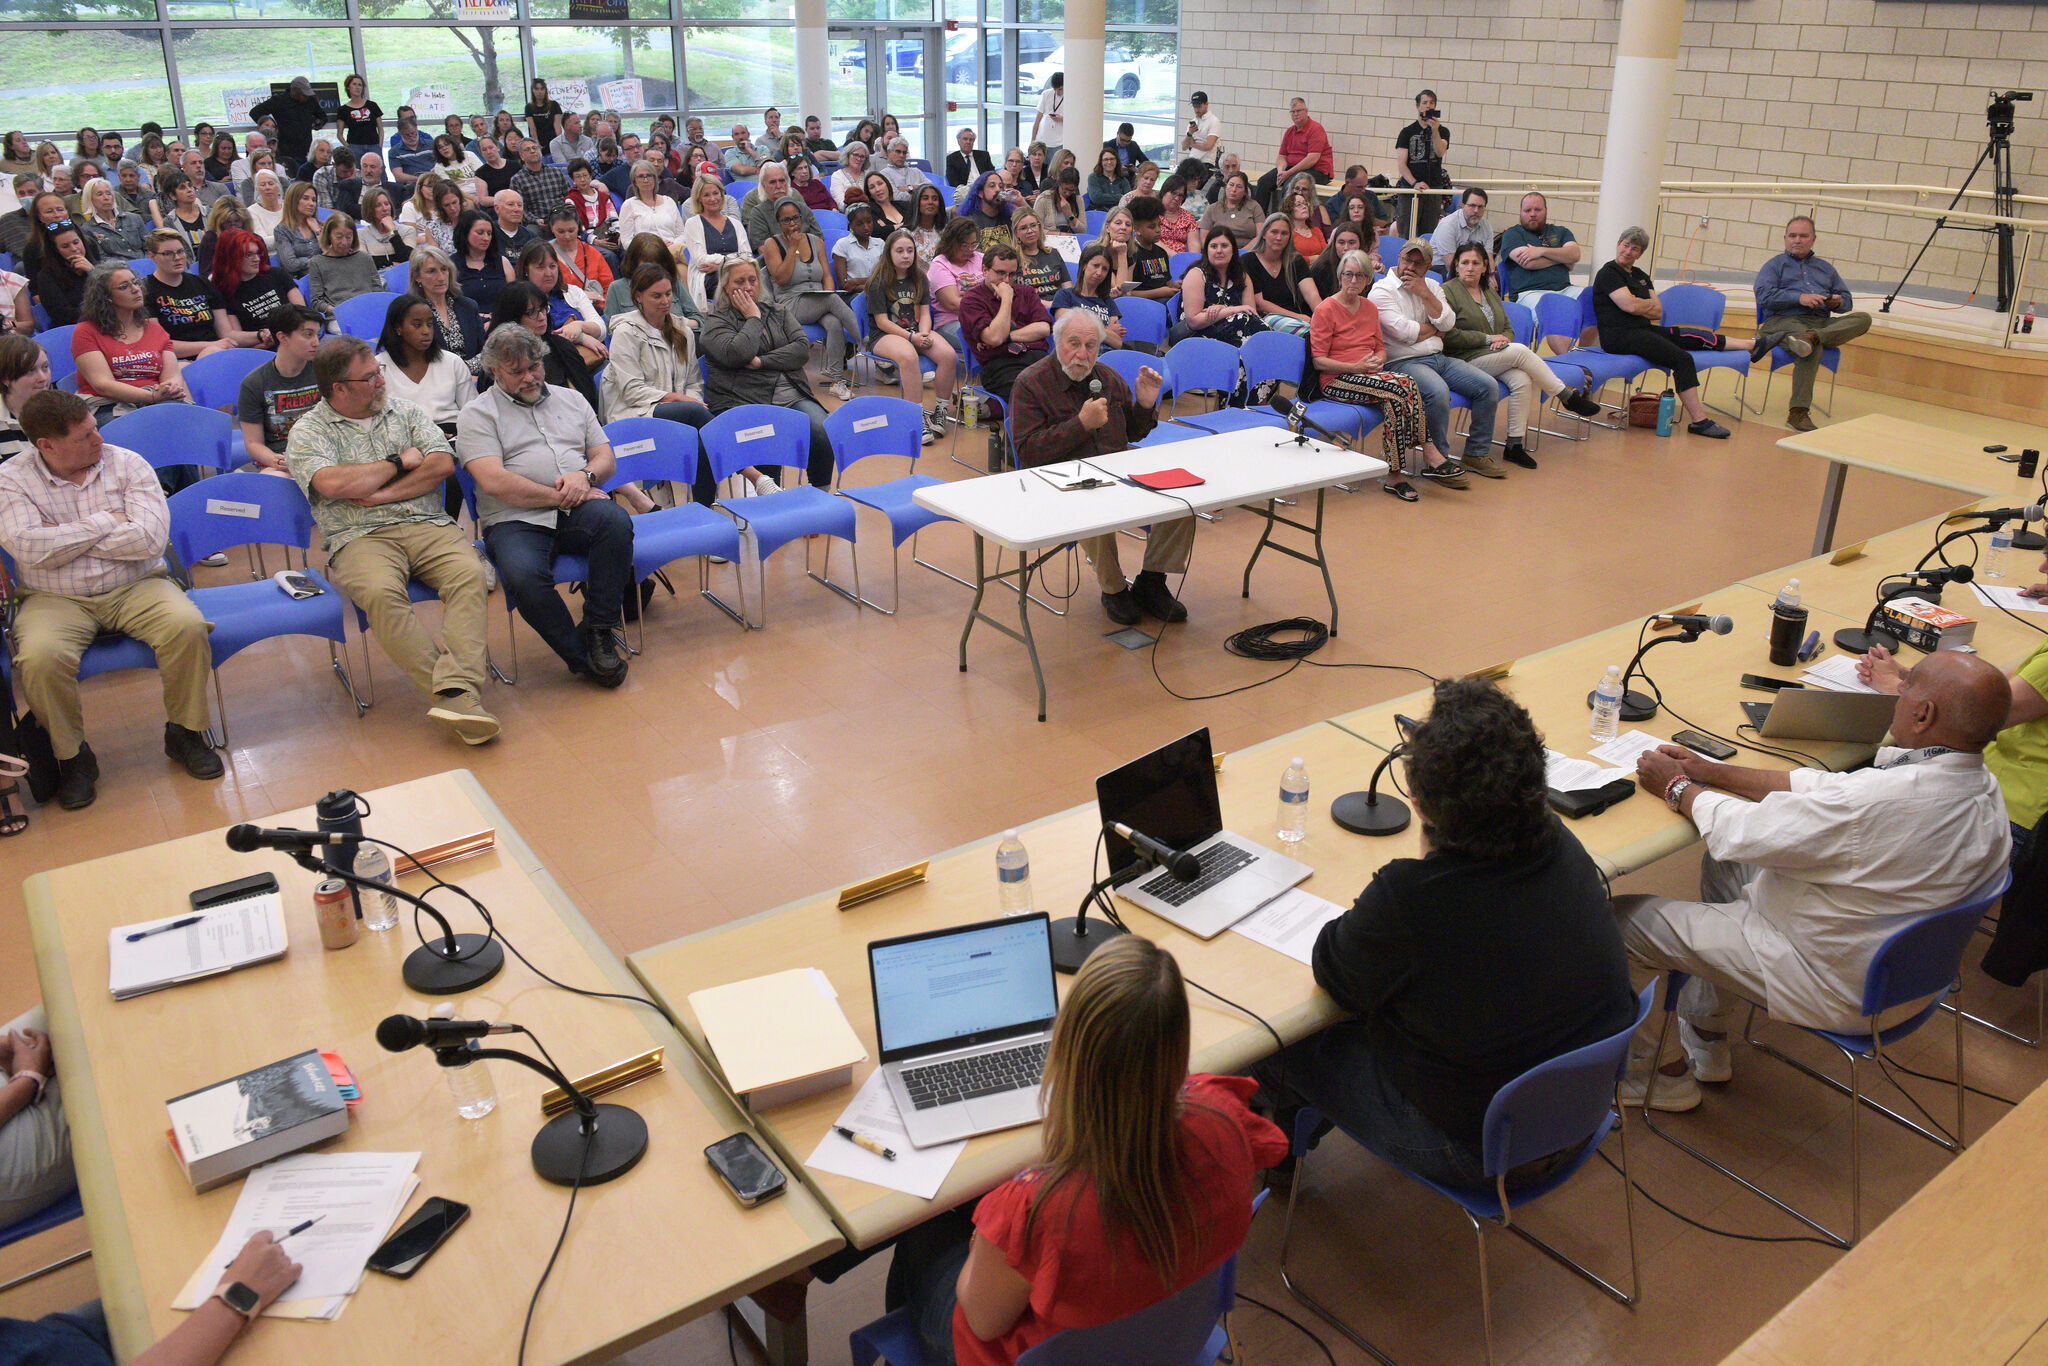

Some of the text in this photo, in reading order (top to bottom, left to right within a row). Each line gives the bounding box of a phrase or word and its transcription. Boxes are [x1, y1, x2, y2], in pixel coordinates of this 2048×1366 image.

[228, 98, 247, 108] BAN
[230, 111, 248, 122] NOT
[156, 295, 207, 307] Literacy
[168, 313, 195, 326] For
[111, 351, 153, 364] READING
[743, 428, 764, 438] Reserved
[622, 444, 644, 453] Reserved
